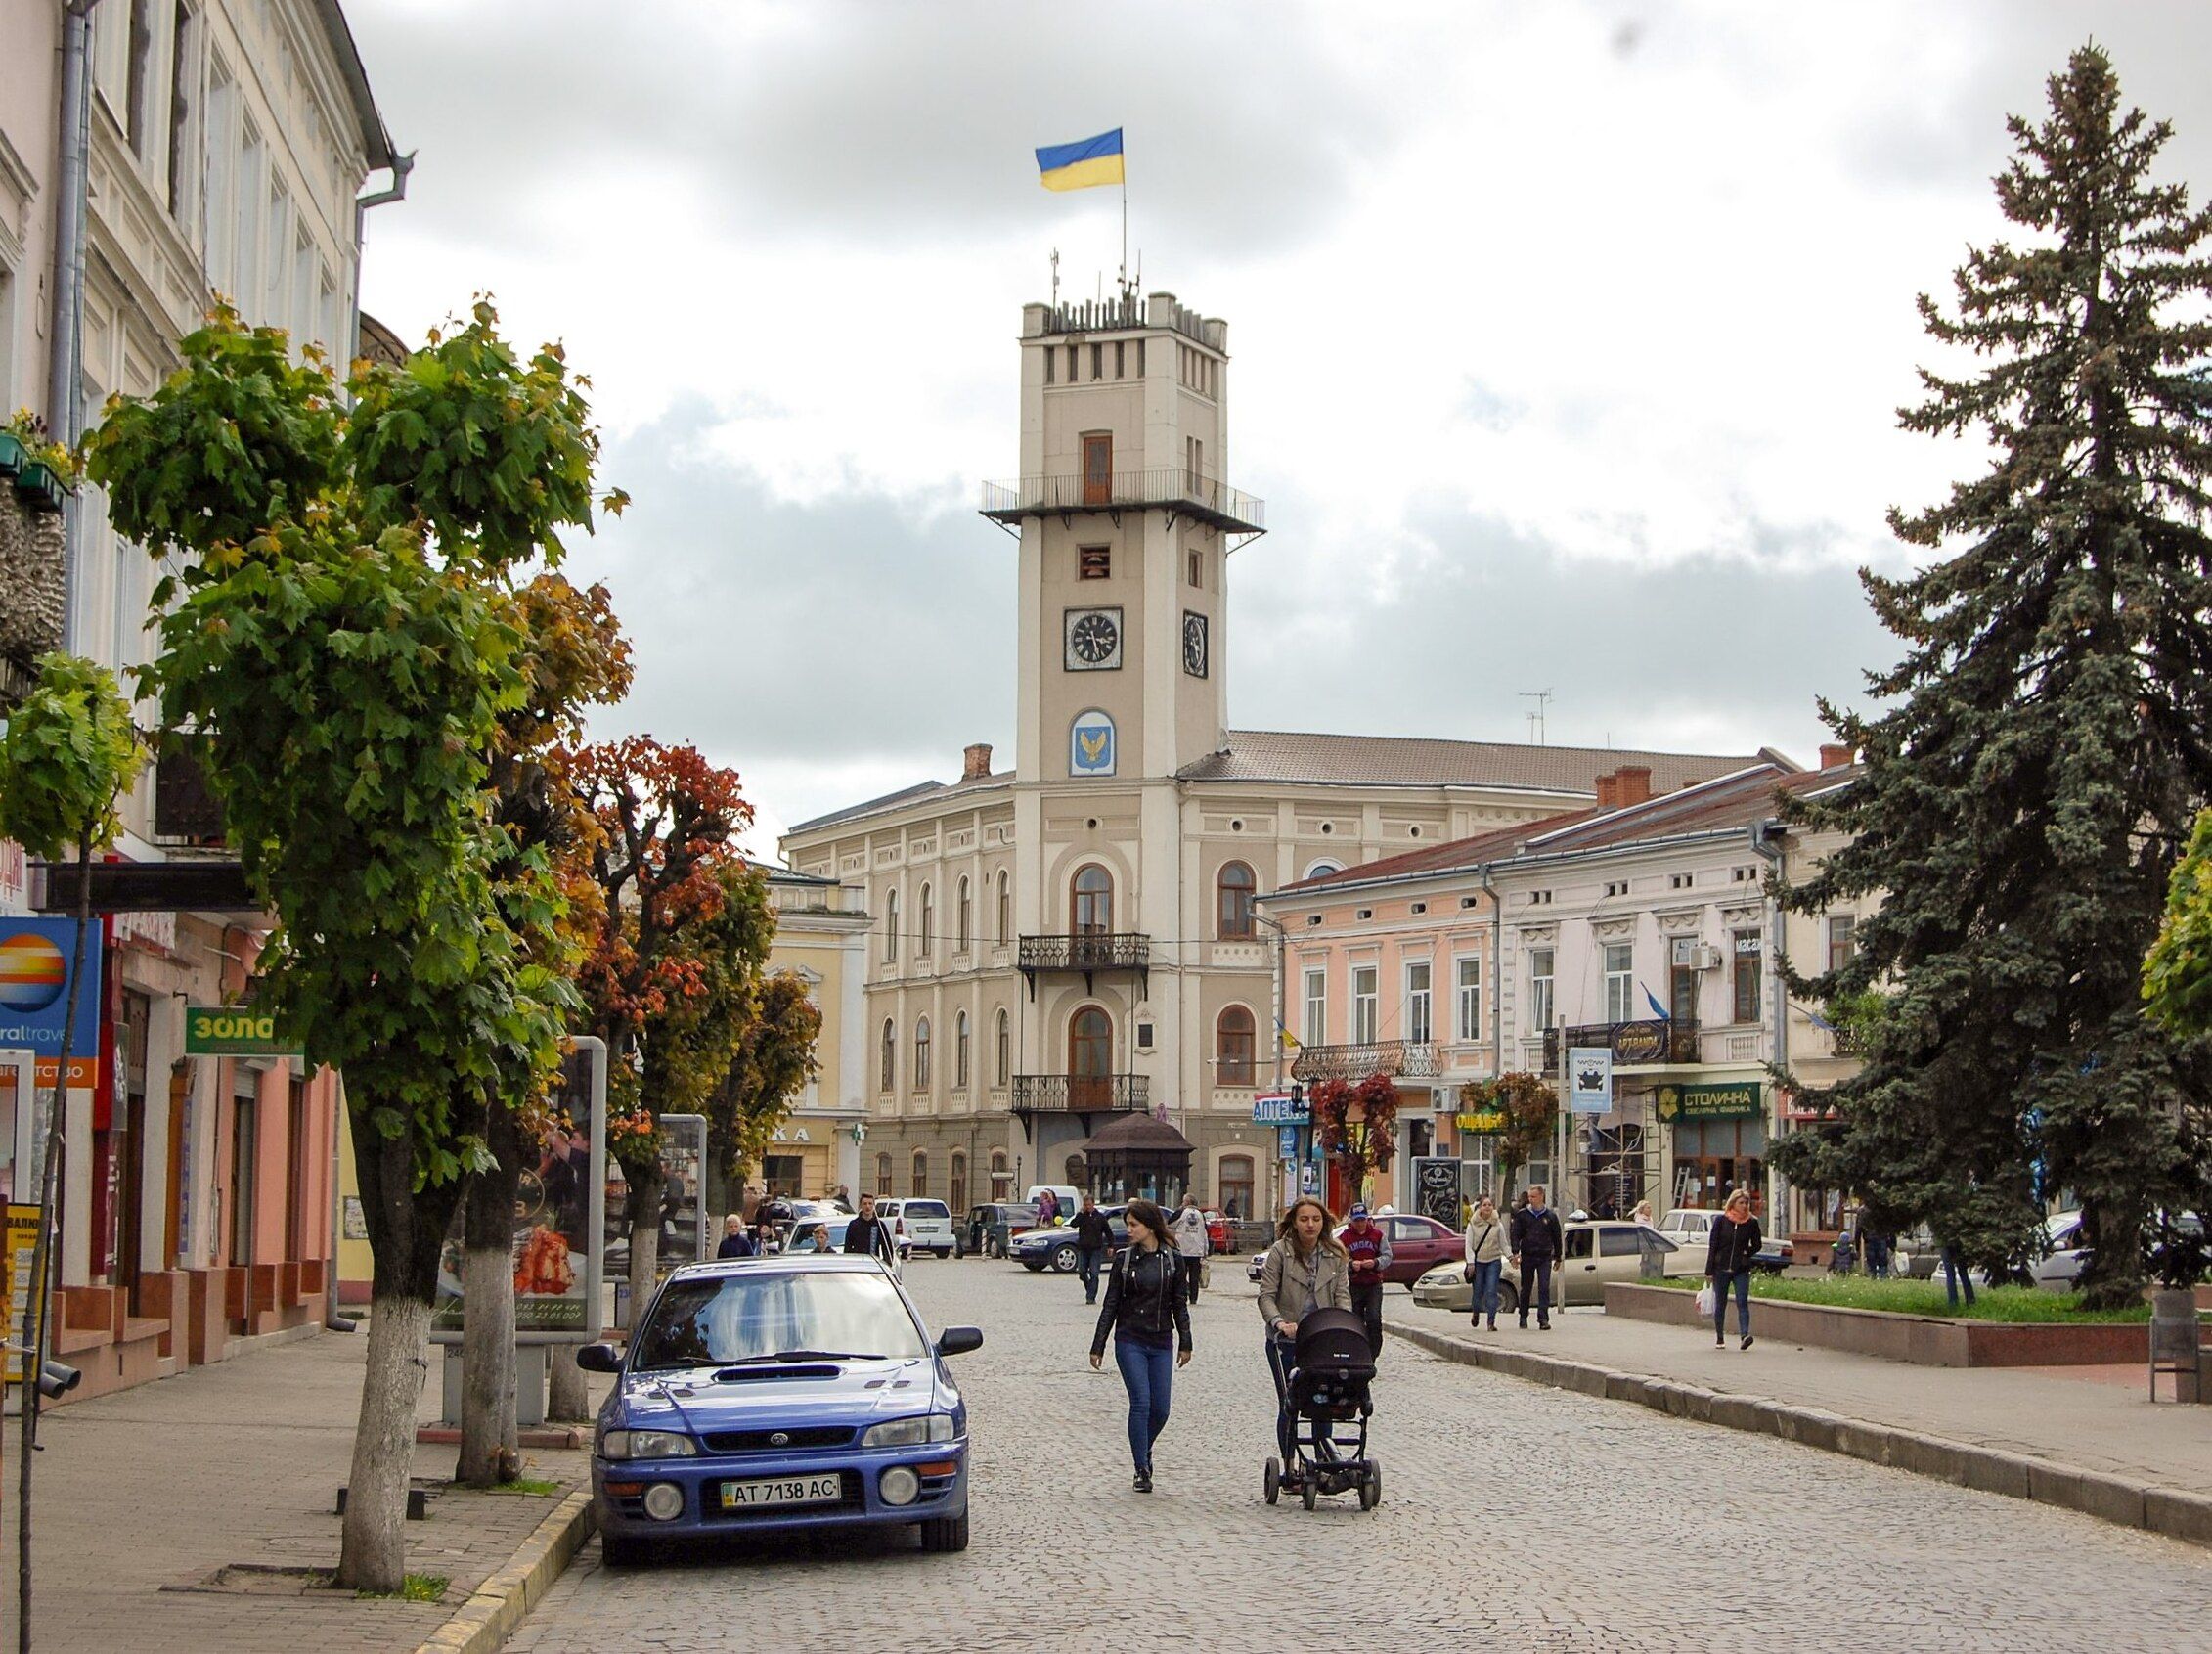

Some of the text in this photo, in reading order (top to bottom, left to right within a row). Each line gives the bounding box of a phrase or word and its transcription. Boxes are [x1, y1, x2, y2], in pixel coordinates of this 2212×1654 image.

[195, 1017, 274, 1039] ЗОЛО
[7, 1217, 39, 1229] ВАЛЮ
[735, 1479, 834, 1503] AT 7138 AC
